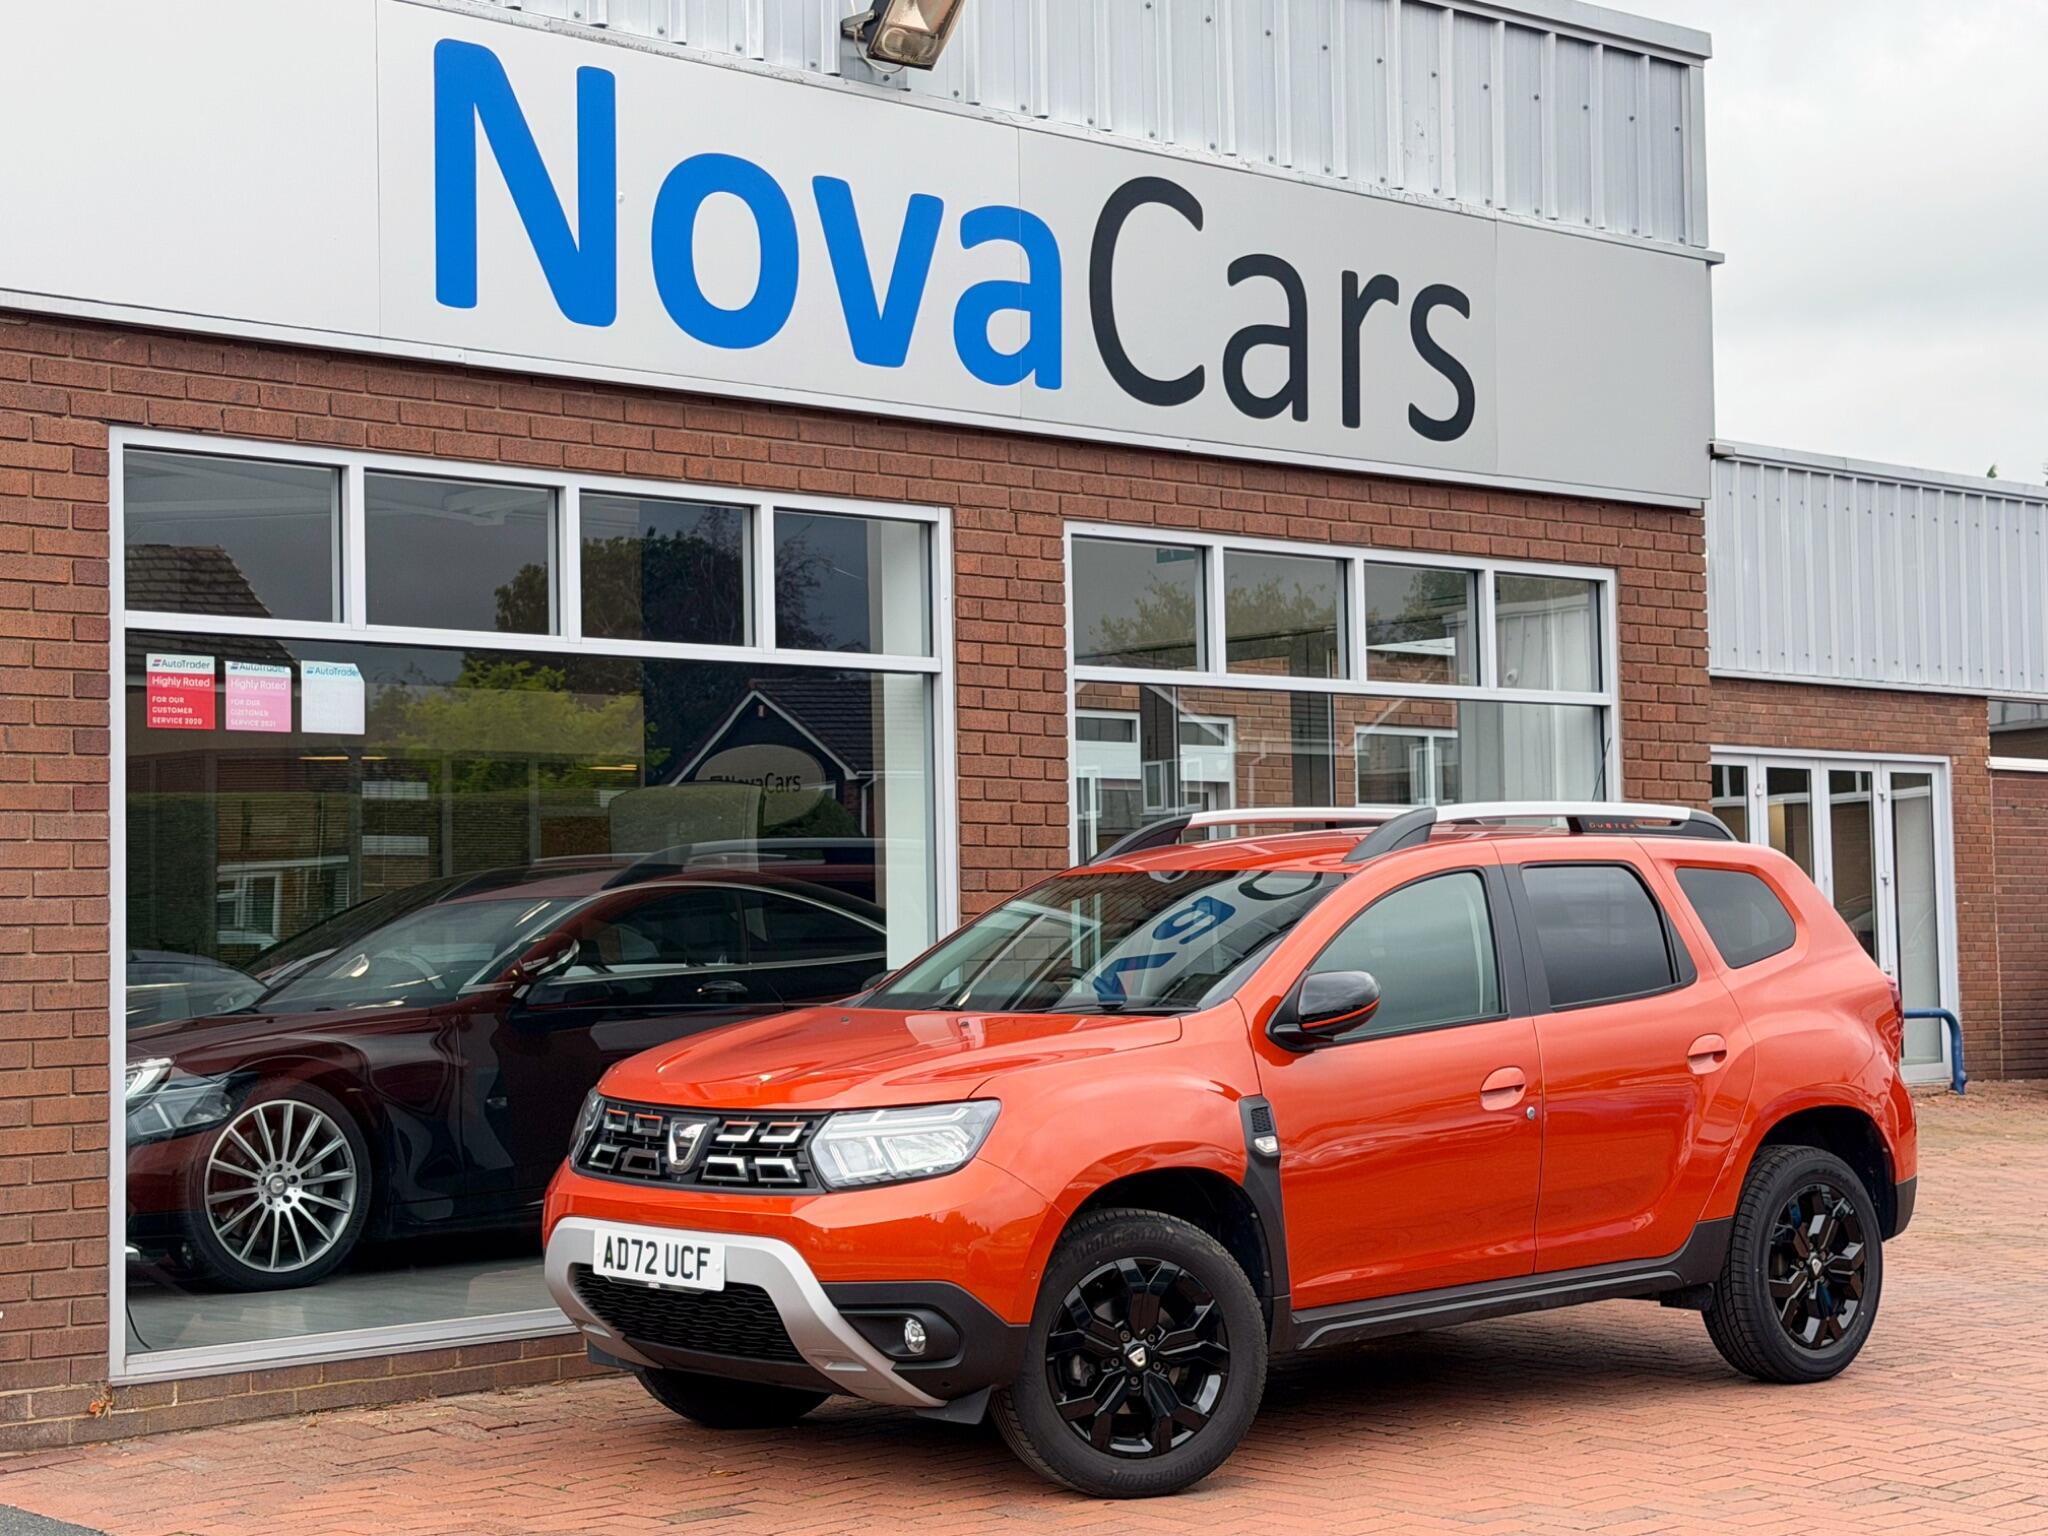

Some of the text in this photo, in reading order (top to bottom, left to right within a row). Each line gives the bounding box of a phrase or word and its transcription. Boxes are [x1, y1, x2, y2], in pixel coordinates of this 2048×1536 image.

[434, 38, 1475, 442] NovaCars
[162, 659, 210, 669] AutoTrader
[152, 675, 210, 688] Highly Rated
[230, 680, 287, 690] Highly Rated
[152, 706, 193, 714] CUSTOMER
[152, 716, 183, 725] SERVICE
[602, 1235, 711, 1281] AD72 UCF
